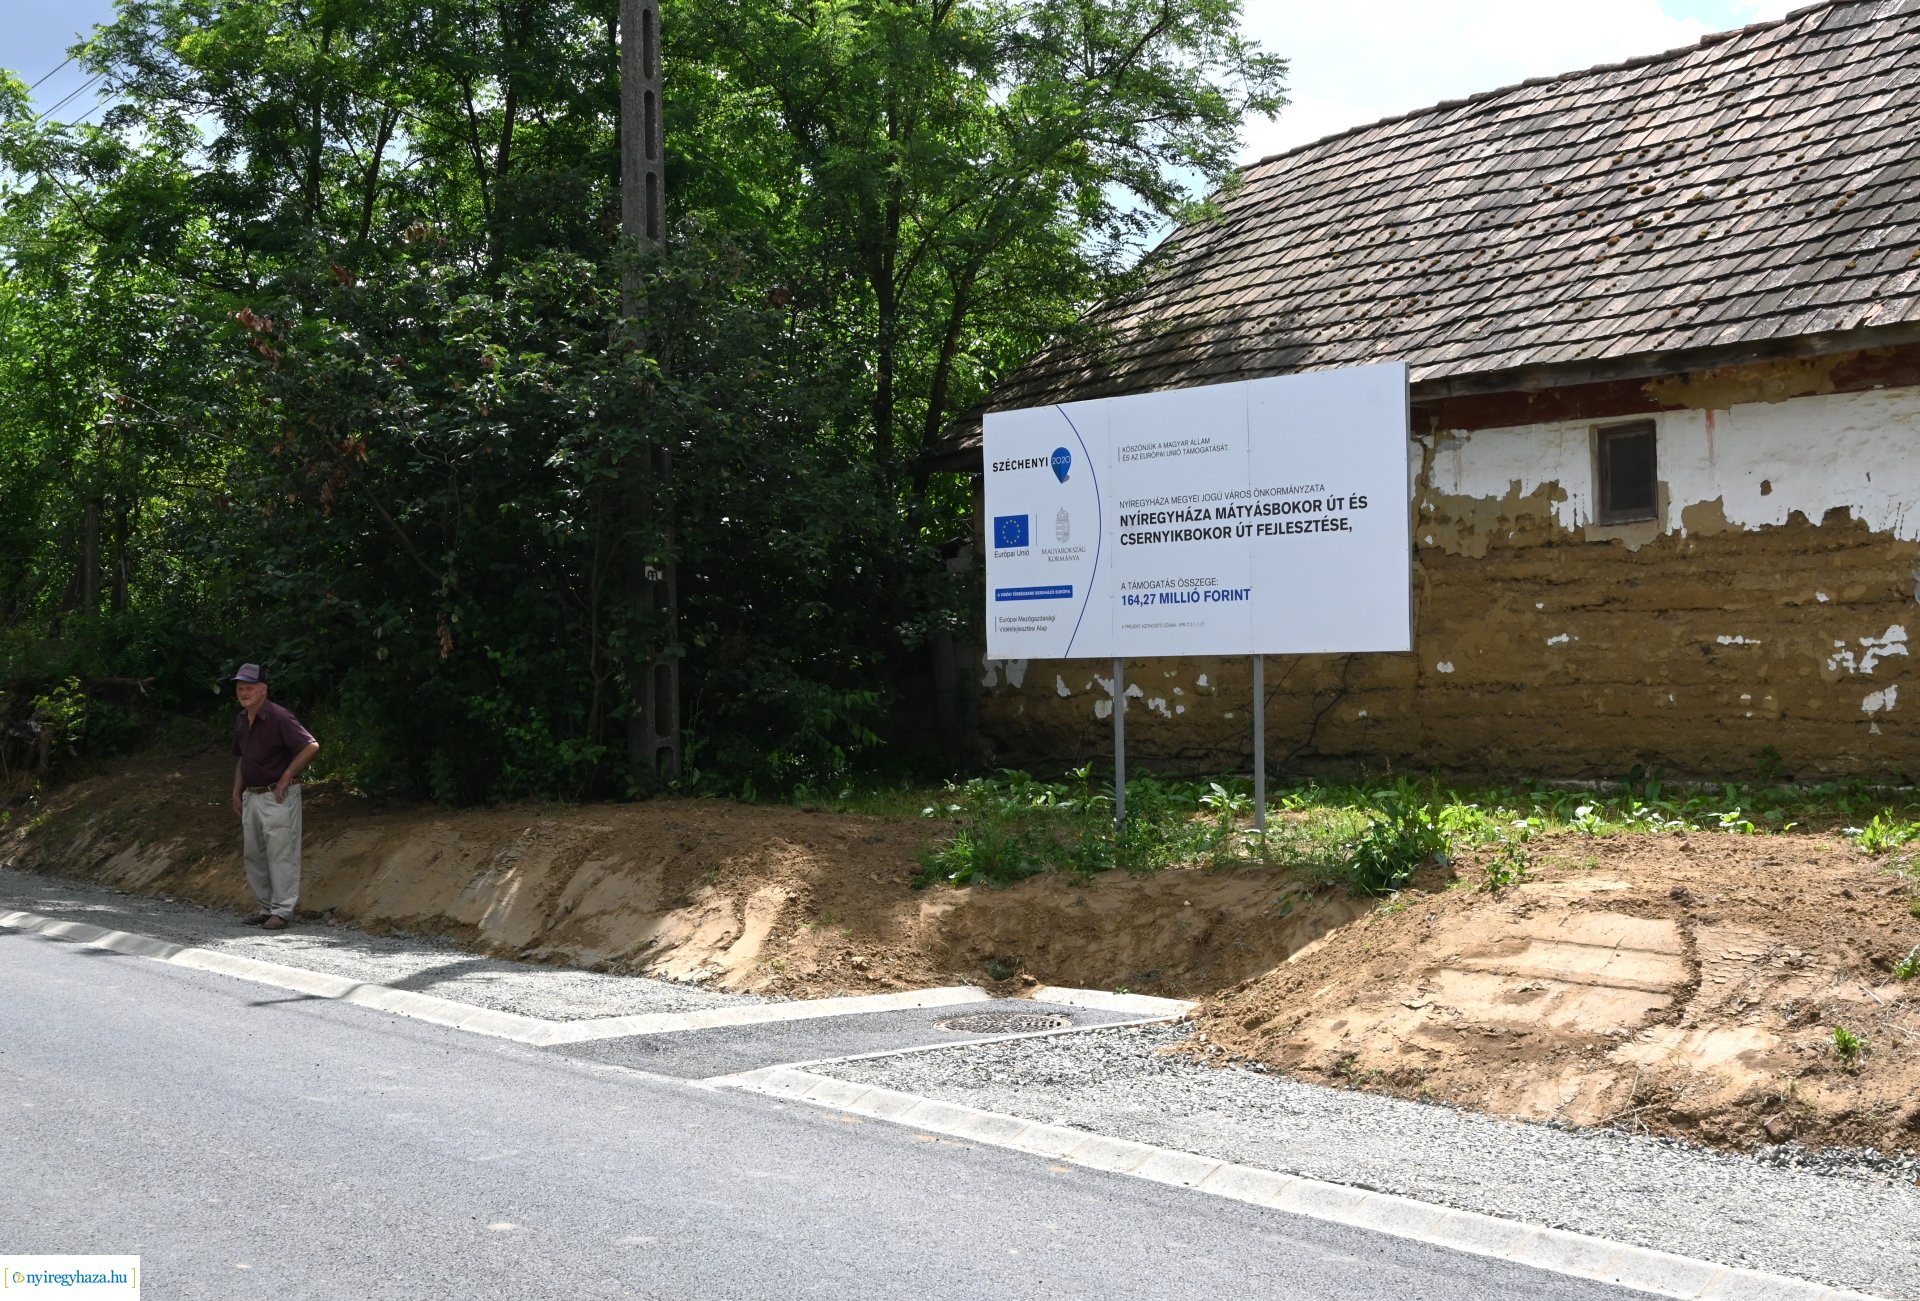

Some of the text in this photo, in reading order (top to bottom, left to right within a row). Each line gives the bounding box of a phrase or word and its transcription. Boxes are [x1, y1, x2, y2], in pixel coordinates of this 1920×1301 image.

[1122, 443, 1157, 453] KÖSZÖNJÜK
[1163, 440, 1189, 449] MAGYAR
[1190, 437, 1211, 446] ÁLLAM
[1122, 452, 1130, 462] ÉS
[1131, 453, 1139, 461] AZ
[1140, 450, 1166, 460] EURÓPAI
[1166, 447, 1182, 457] UNIÓ
[992, 455, 1071, 472] SZÉCHENYI 2020
[1119, 483, 1326, 509] NYÍREGYHÁZA MEGYEI JOGÚ VÁROS ÖNKORMÁNYZATA
[1120, 492, 1368, 527] NYÍREGYHÁZA MÁTYÁSBOKOR ÚT ÉS
[1120, 515, 1353, 546] CSERNYIKBOKOR ÚT FEJLESZTÉSE,
[994, 548, 1030, 559] Európai Unió
[1121, 577, 1219, 591] A TÁMOGATÁS ÖSSZEGE:
[1121, 587, 1251, 607] 164,27 MILLIÓ FORINT
